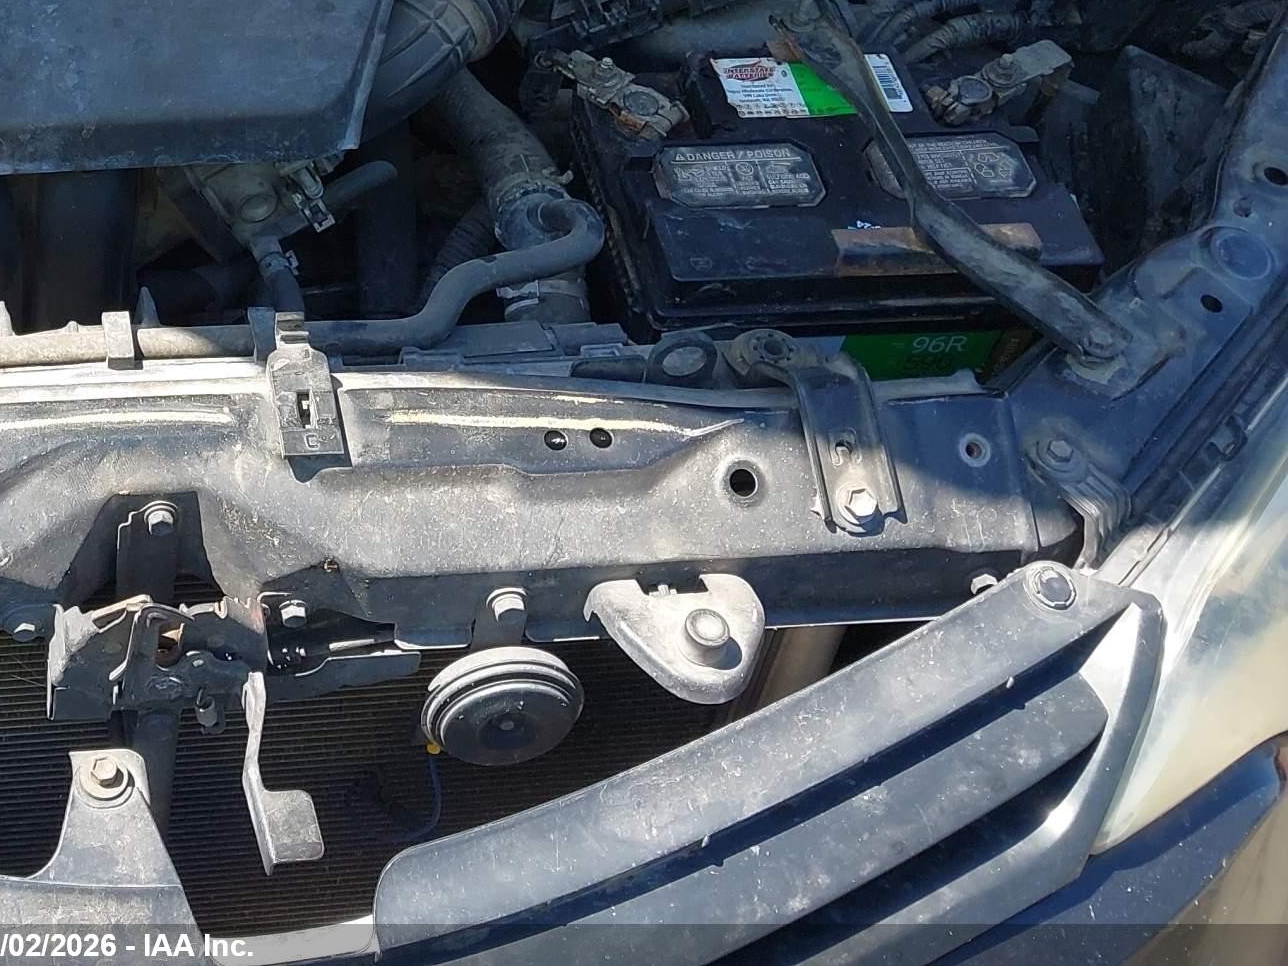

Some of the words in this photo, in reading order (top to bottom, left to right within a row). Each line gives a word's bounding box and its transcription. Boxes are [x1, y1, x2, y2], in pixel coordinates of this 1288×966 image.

[687, 150, 736, 161] DANGER
[746, 148, 791, 158] POISON
[912, 336, 968, 353] 96R
